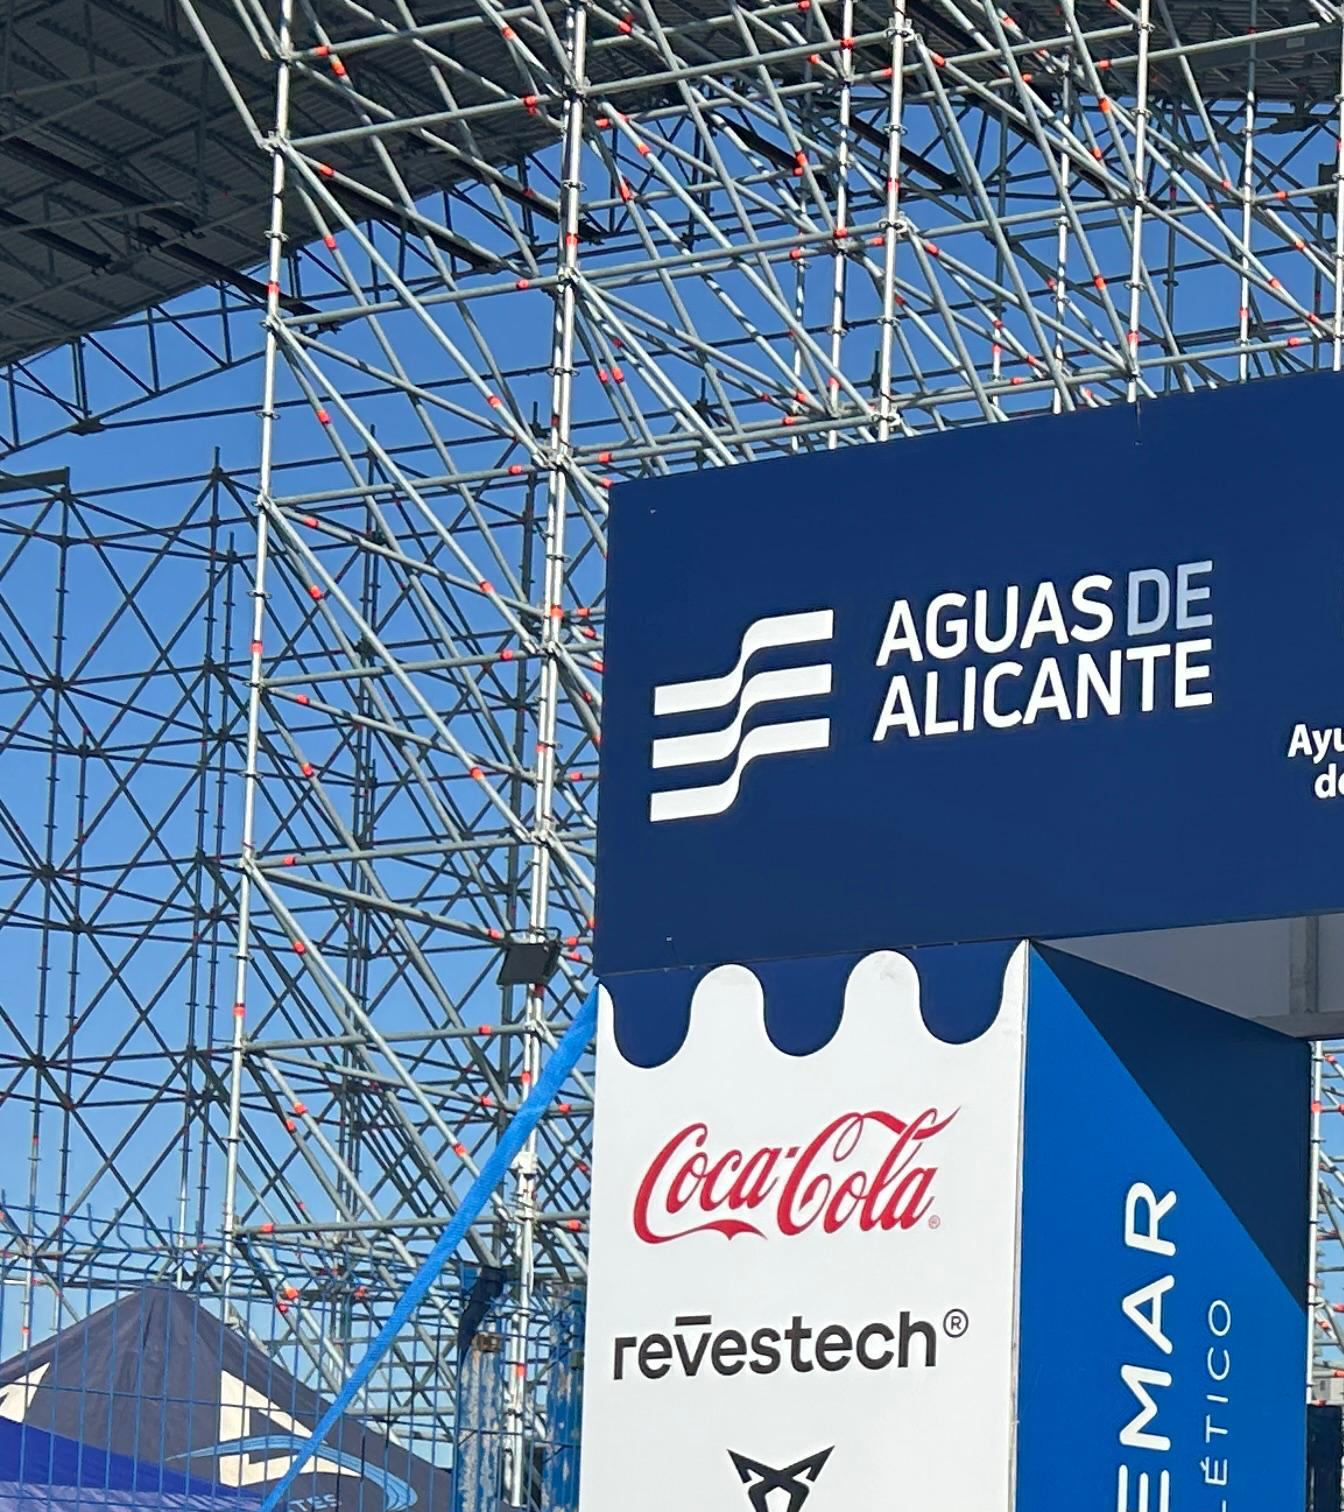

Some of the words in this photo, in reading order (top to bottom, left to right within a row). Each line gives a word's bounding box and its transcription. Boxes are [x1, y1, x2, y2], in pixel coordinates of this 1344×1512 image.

[875, 574, 1112, 668] AGUAS
[1127, 559, 1214, 637] DE
[872, 638, 1214, 741] ALICANTE
